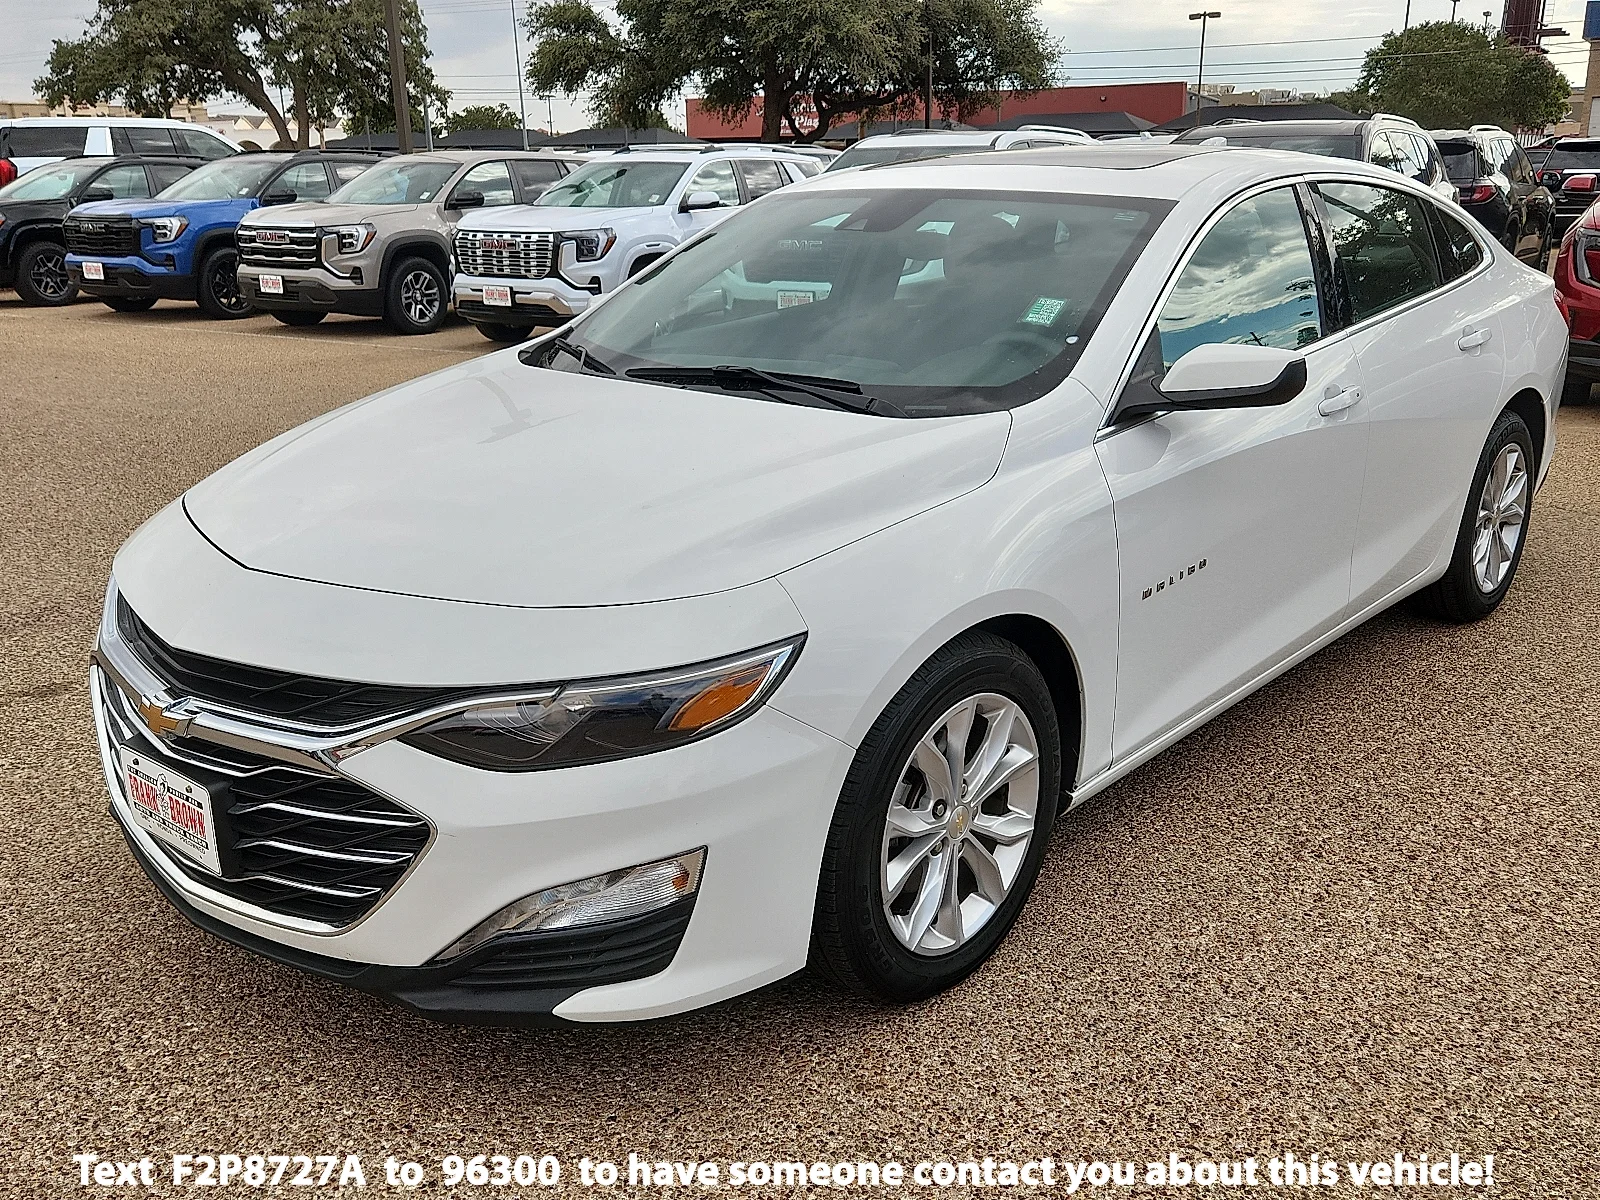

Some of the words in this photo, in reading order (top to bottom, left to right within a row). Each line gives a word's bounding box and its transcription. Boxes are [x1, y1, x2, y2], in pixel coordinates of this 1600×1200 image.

[256, 231, 285, 241] GMC
[482, 239, 516, 250] GMC
[778, 239, 823, 250] GMC
[1141, 558, 1207, 601] MALIBU
[128, 773, 161, 814] FRANK
[168, 794, 207, 841] BROWN
